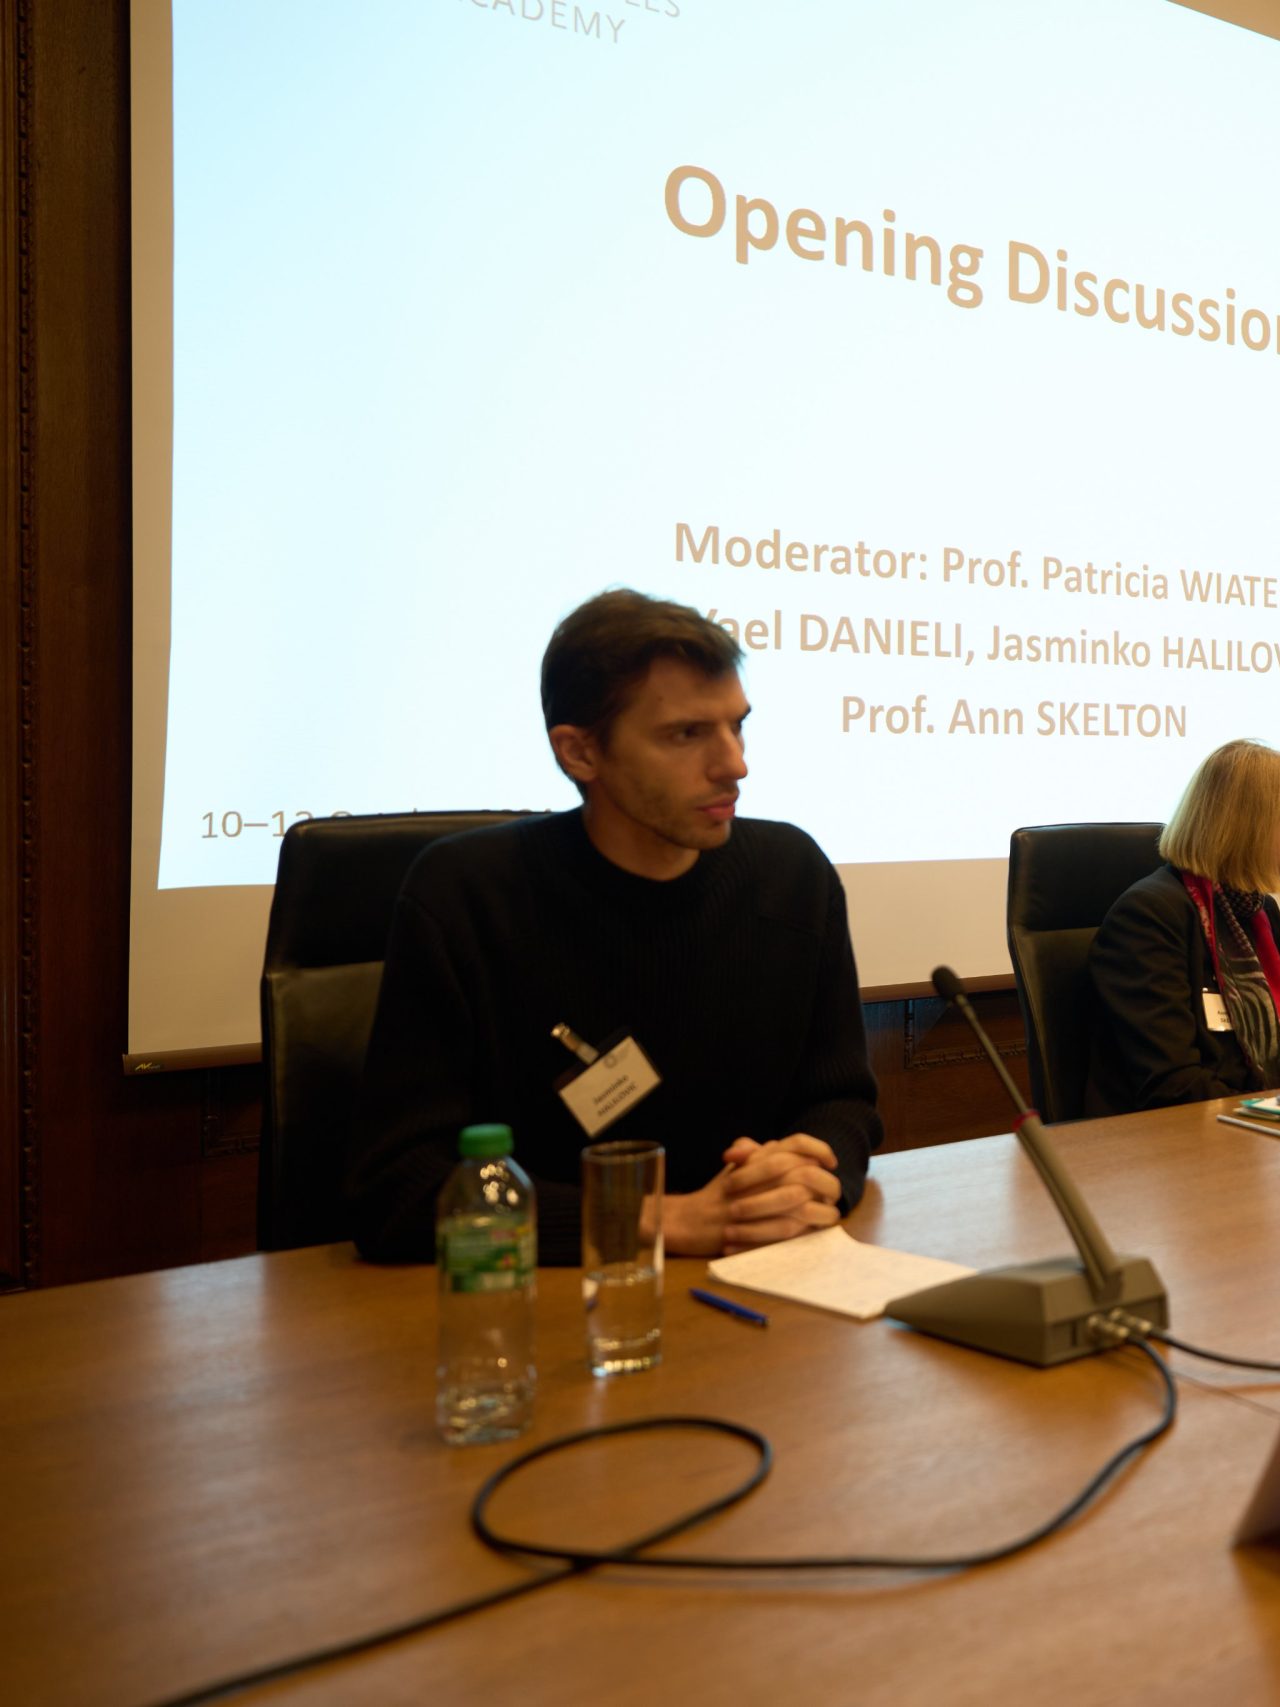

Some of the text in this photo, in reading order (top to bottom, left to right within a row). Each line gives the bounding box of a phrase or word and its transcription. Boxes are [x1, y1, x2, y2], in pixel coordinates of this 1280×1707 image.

[663, 164, 984, 310] Opening
[675, 522, 928, 582] Moderator:
[943, 546, 1029, 589] Prof.
[1042, 556, 1169, 600] Patricia
[799, 613, 975, 667] DANIELI,
[986, 625, 1151, 669] Jasminko
[842, 695, 1186, 738] Prof. Ann SKELTON
